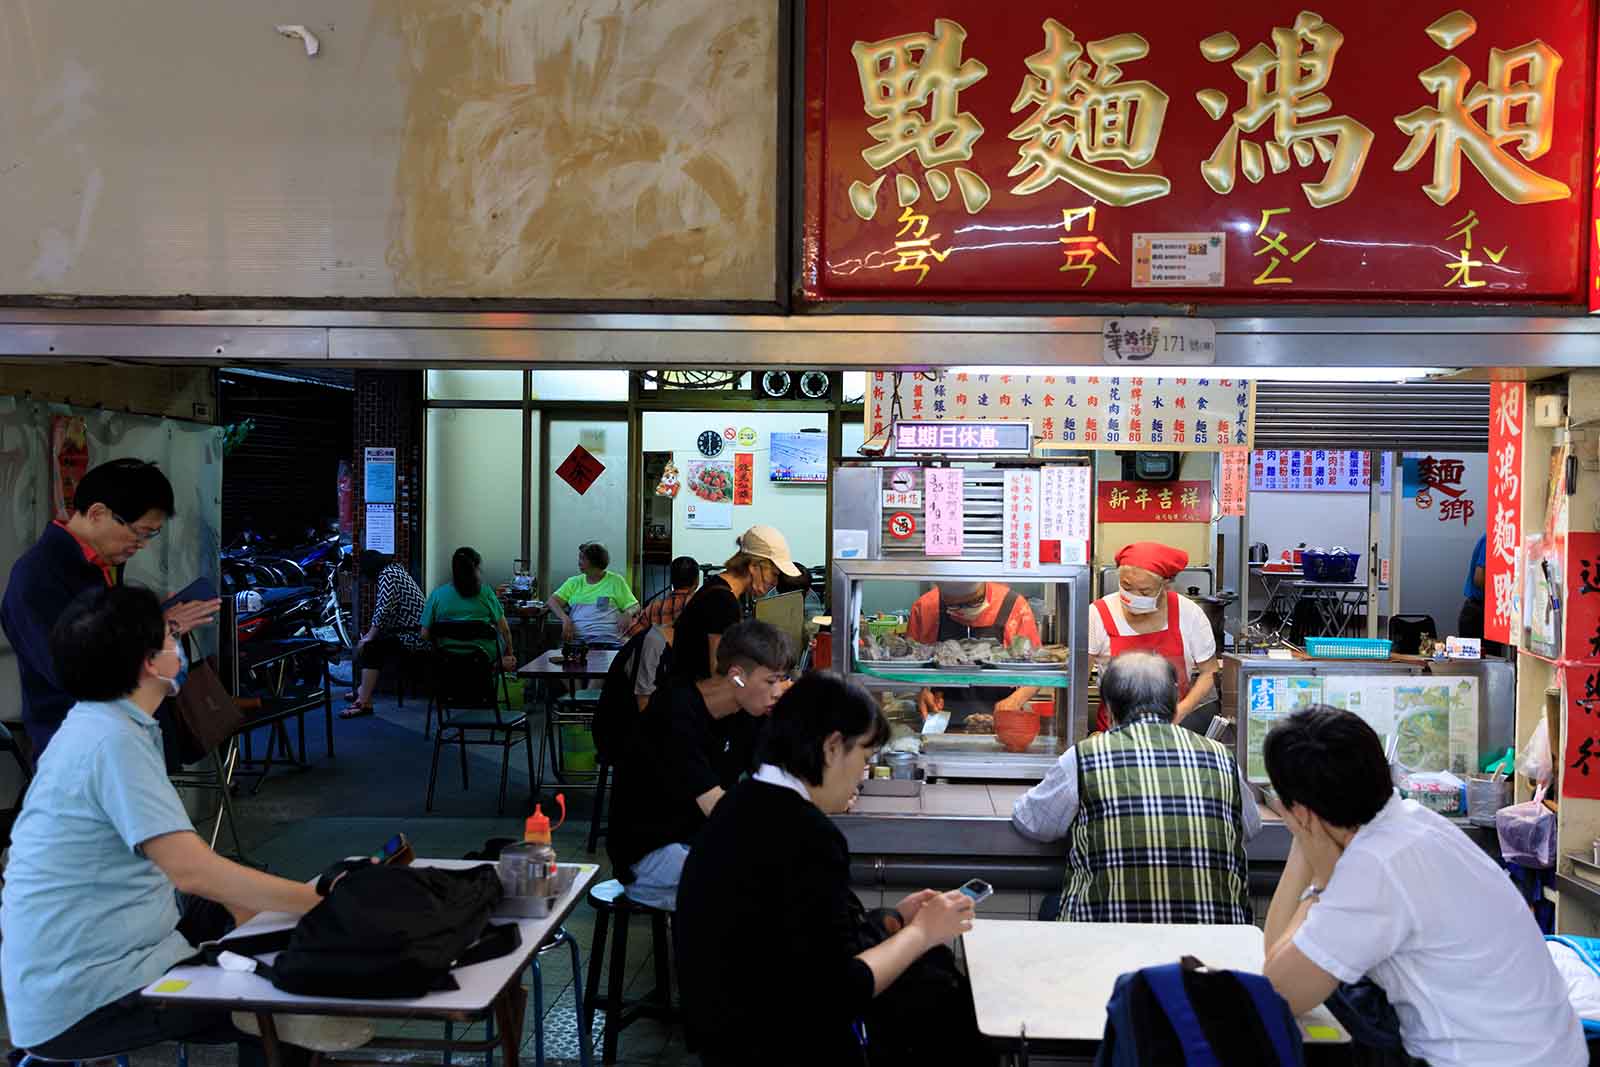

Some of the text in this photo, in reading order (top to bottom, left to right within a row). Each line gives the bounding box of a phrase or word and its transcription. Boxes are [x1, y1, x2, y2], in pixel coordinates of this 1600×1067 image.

[1162, 335, 1185, 352] 171
[898, 426, 999, 448] 星期日休息
[1042, 430, 1054, 440] 35
[1085, 431, 1097, 441] 90
[1107, 432, 1119, 442] 90
[1174, 433, 1185, 443] 70
[1194, 434, 1207, 443] 65
[1217, 434, 1229, 444] 35
[1108, 487, 1201, 511] 新年吉祥
